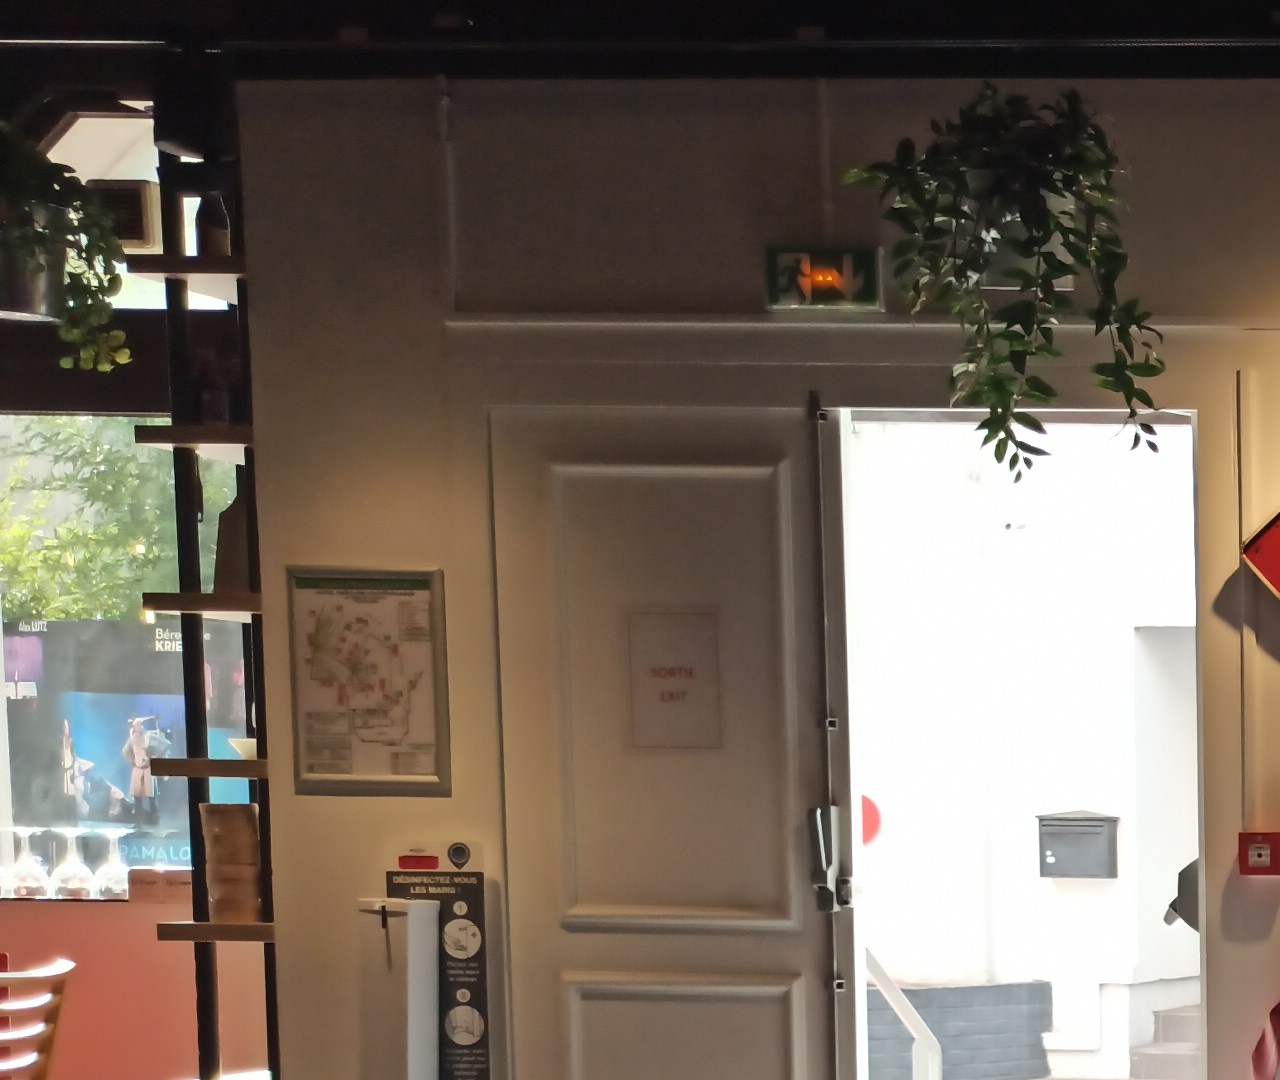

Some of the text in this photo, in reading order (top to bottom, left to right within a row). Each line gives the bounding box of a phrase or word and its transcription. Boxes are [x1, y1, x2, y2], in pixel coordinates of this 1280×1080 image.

[31, 620, 48, 632] LUTZ
[155, 640, 183, 651] KRIE
[650, 667, 696, 679] SORTIE
[660, 691, 687, 703] EXIT
[410, 886, 427, 894] LES
